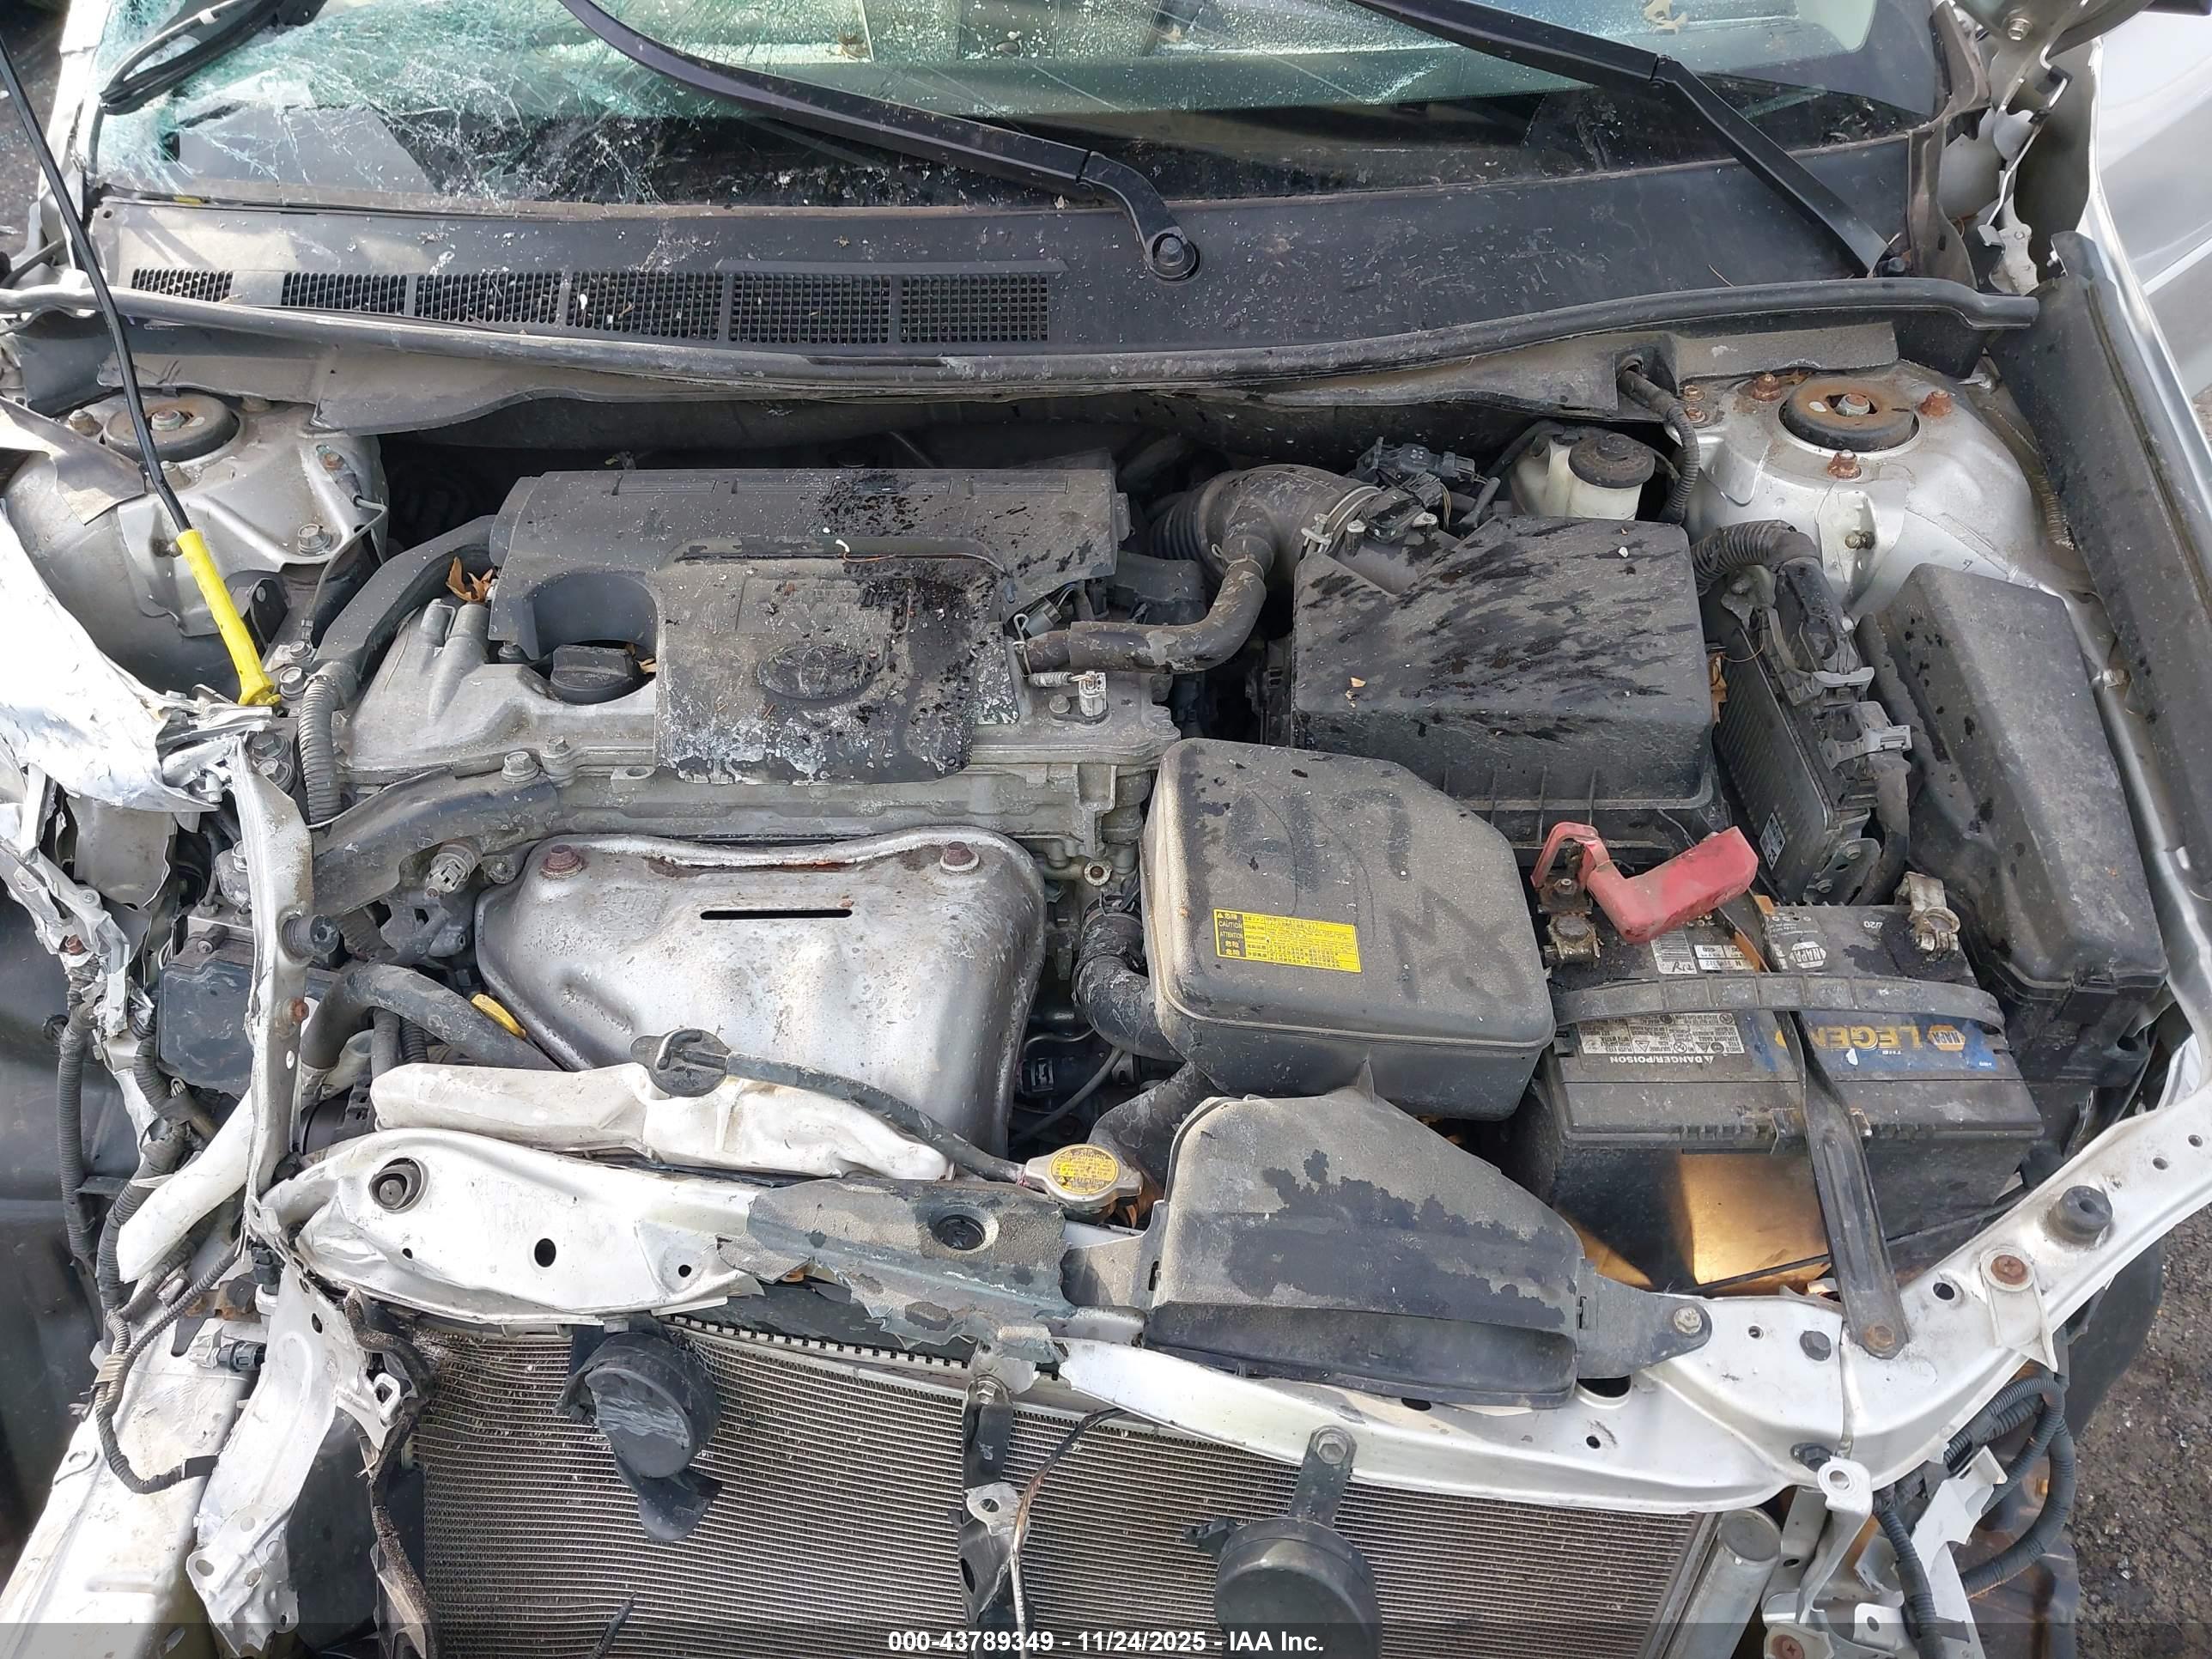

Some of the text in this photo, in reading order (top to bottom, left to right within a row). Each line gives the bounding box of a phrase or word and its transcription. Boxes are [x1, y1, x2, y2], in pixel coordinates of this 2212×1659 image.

[1218, 921, 1243, 929] CAUTION
[1219, 931, 1243, 939] ATTENTION
[1793, 947, 1821, 963] NAPA
[1775, 1025, 1923, 1050] LEGEN
[1932, 1032, 1960, 1045] NAPA
[1609, 1055, 1704, 1064] DANGER/POISON
